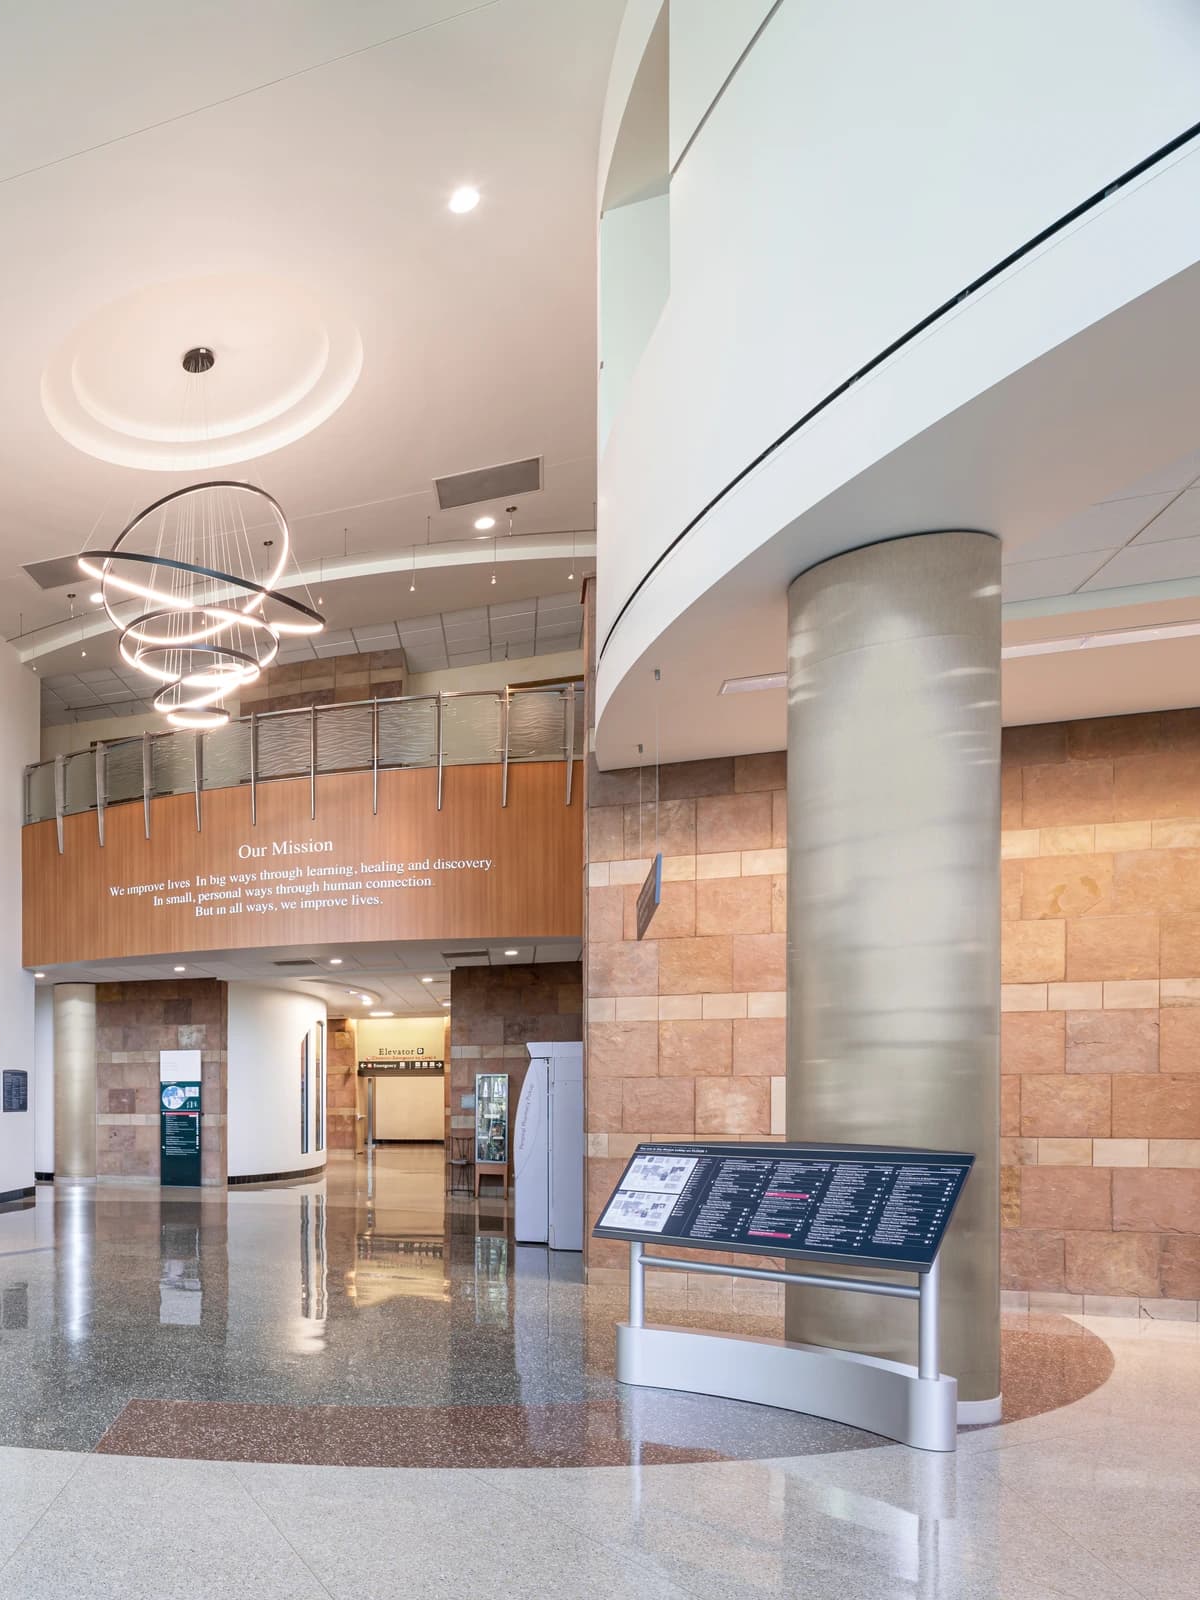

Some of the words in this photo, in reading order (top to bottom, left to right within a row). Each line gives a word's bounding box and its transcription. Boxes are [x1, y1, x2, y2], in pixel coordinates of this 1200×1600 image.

[238, 843, 268, 859] Our
[272, 838, 334, 856] Mission
[109, 886, 126, 897] We
[127, 882, 165, 897] improve
[196, 876, 207, 887] In
[209, 874, 227, 888] big
[230, 873, 257, 885] ways
[260, 867, 303, 884] through
[306, 864, 359, 879] learning,
[360, 860, 405, 875] healing
[408, 858, 430, 871] and
[153, 895, 164, 907] In
[166, 892, 197, 905] small,
[197, 888, 242, 904] personal
[245, 887, 273, 899] ways
[275, 882, 320, 897] through
[323, 879, 363, 892] human
[195, 904, 214, 917] But
[216, 904, 227, 915] in
[229, 903, 243, 914] all
[246, 902, 279, 914] ways,
[281, 901, 297, 910] we
[300, 898, 349, 911] improve
[351, 894, 384, 906] lives.
[378, 1048, 415, 1056] Elevator
